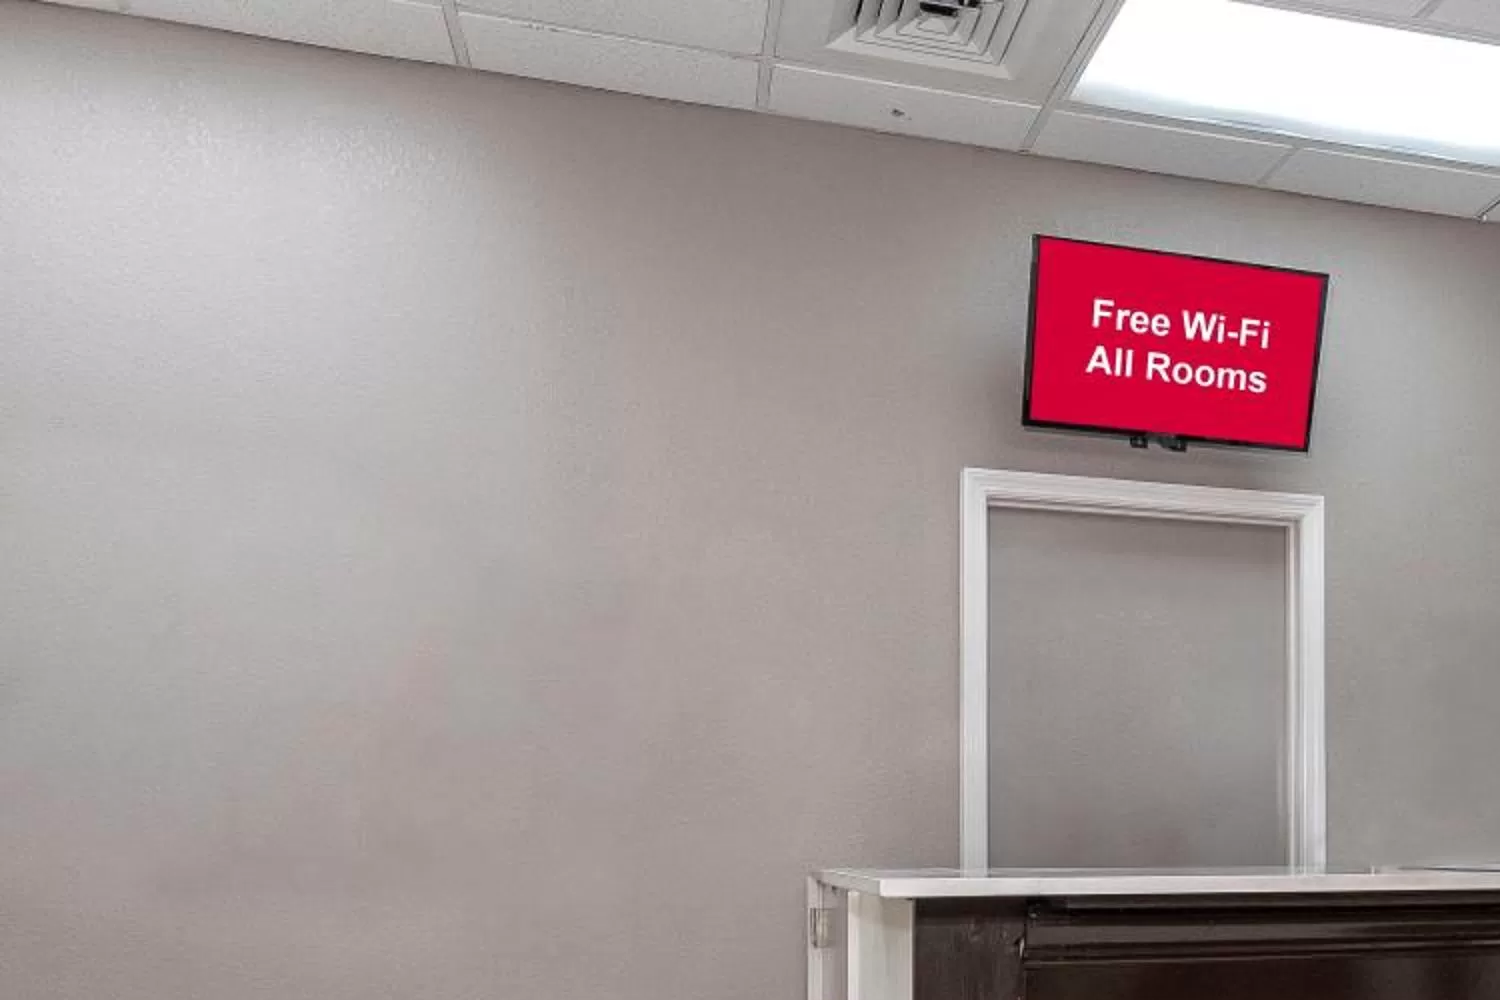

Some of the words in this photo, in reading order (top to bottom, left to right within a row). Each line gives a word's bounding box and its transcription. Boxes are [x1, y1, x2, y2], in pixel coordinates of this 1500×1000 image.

[1092, 298, 1170, 336] Free
[1182, 310, 1270, 349] Wi-Fi
[1086, 345, 1133, 377] All
[1146, 351, 1266, 393] Rooms
